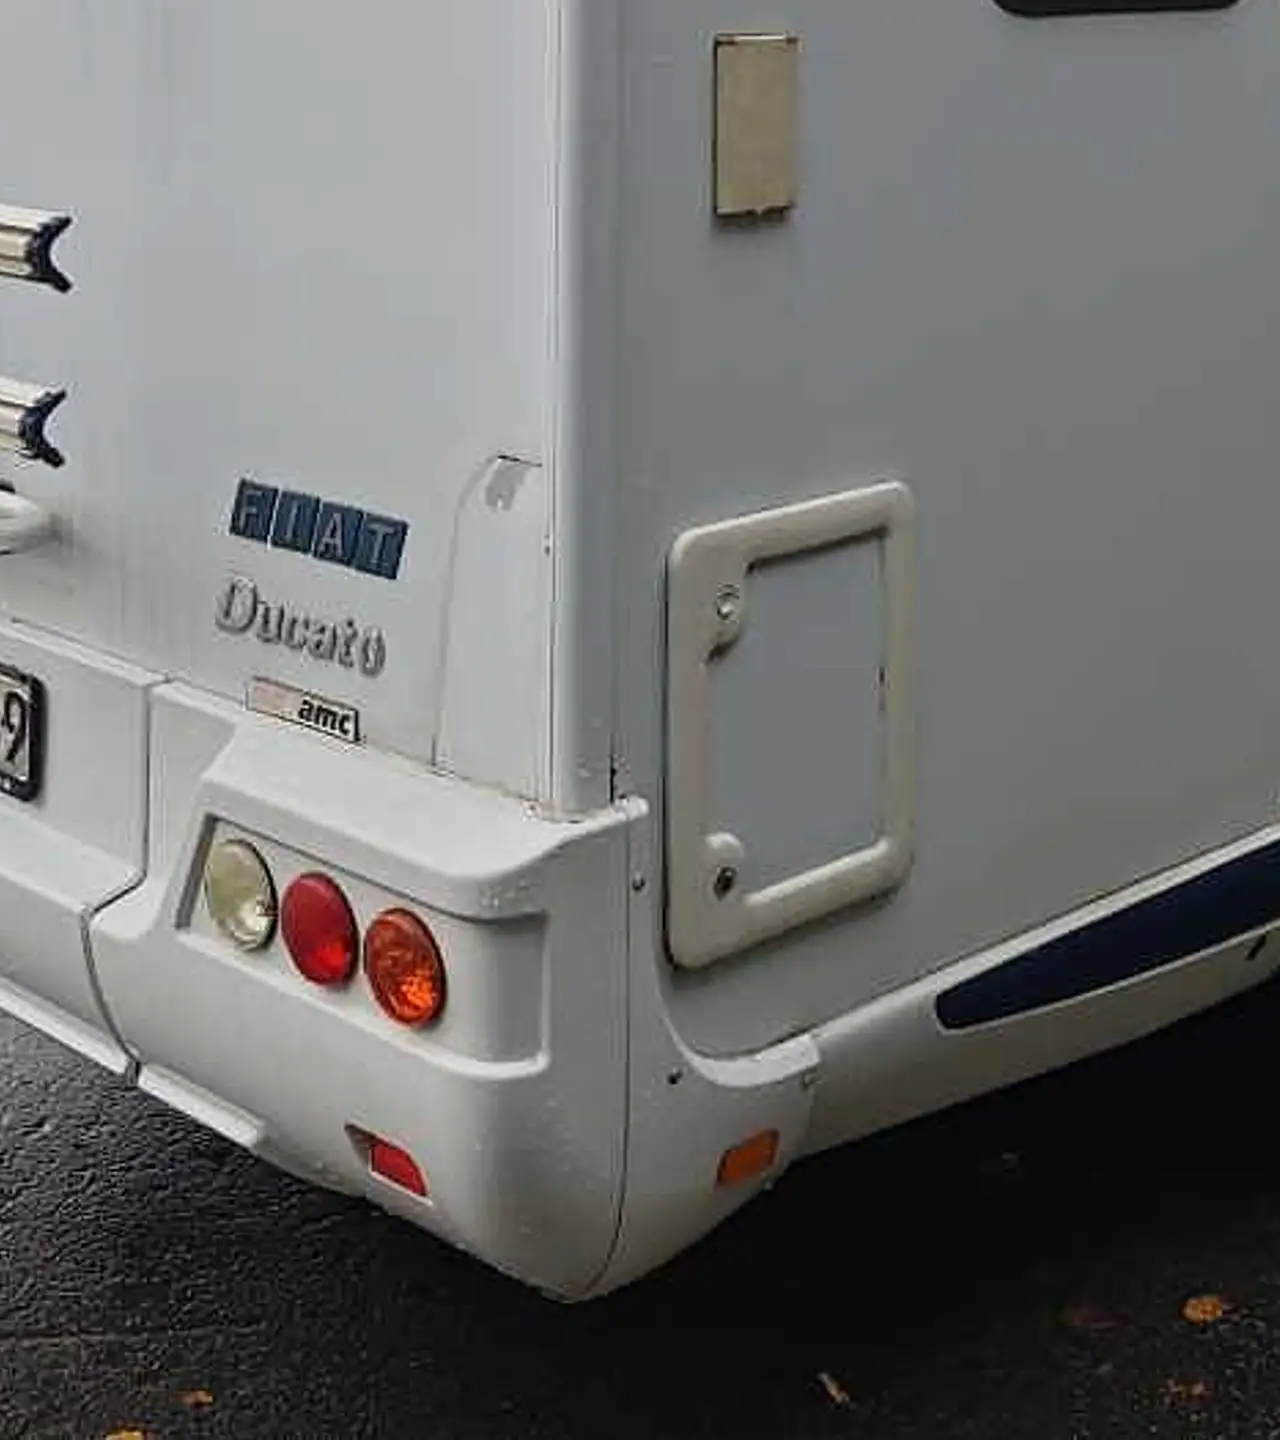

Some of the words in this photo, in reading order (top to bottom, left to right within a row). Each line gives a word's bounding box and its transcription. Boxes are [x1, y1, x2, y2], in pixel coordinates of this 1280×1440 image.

[235, 486, 400, 572] FIAT
[215, 576, 387, 677] Ducato
[297, 698, 351, 736] amc
